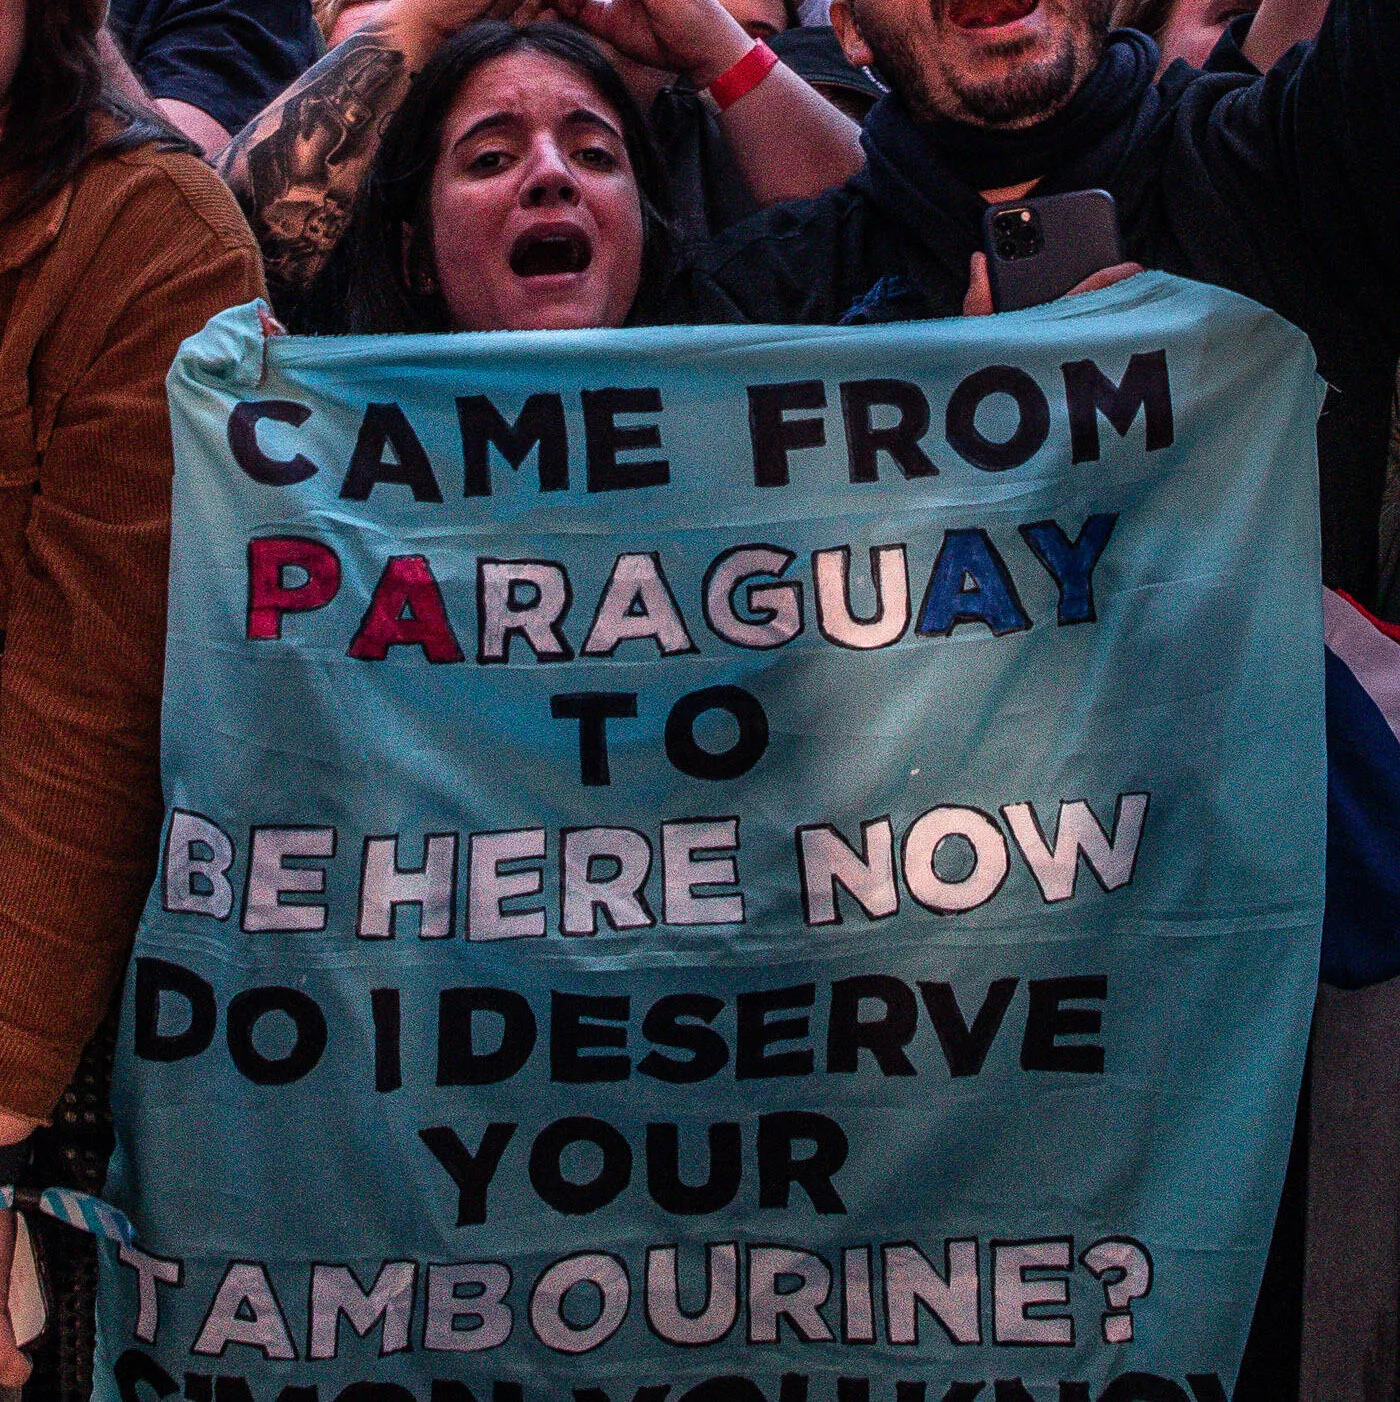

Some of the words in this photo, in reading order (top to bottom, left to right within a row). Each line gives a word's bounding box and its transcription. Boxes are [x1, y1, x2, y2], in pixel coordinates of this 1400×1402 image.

[228, 386, 671, 504] CAME
[746, 349, 1176, 489] FROM
[245, 511, 1117, 664] PARAGUAY
[550, 684, 770, 787] TO
[160, 806, 339, 936] BE
[355, 815, 745, 942] HERE
[799, 791, 1150, 927] NOW
[131, 955, 330, 1088] DO
[370, 987, 404, 1094] I
[434, 973, 1112, 1089] DESERVE
[416, 1110, 850, 1229] YOUR
[117, 1235, 1154, 1362] TAMBOURINE?
